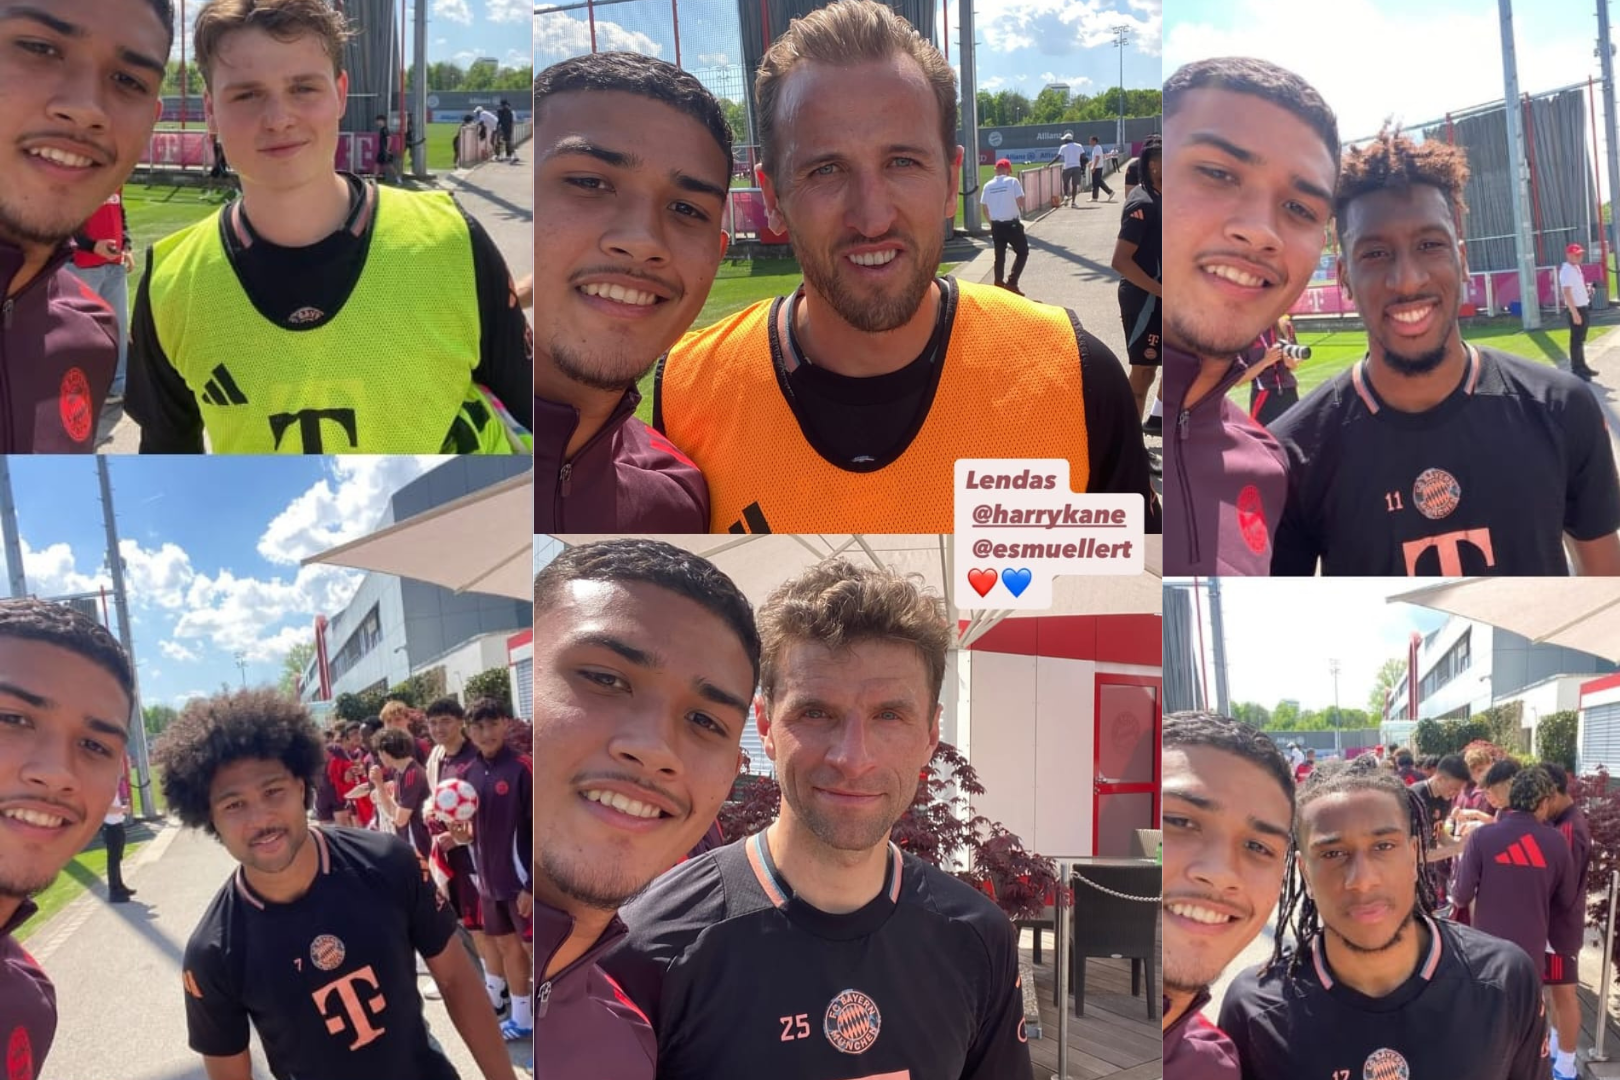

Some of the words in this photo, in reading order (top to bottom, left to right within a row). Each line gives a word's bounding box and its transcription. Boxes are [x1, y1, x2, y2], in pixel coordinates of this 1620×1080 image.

[1385, 491, 1403, 512] 11
[293, 957, 302, 972] 7
[311, 965, 386, 1051] T
[829, 1003, 842, 1019] FC
[840, 994, 876, 1016] BAYERN
[780, 1013, 811, 1042] 25
